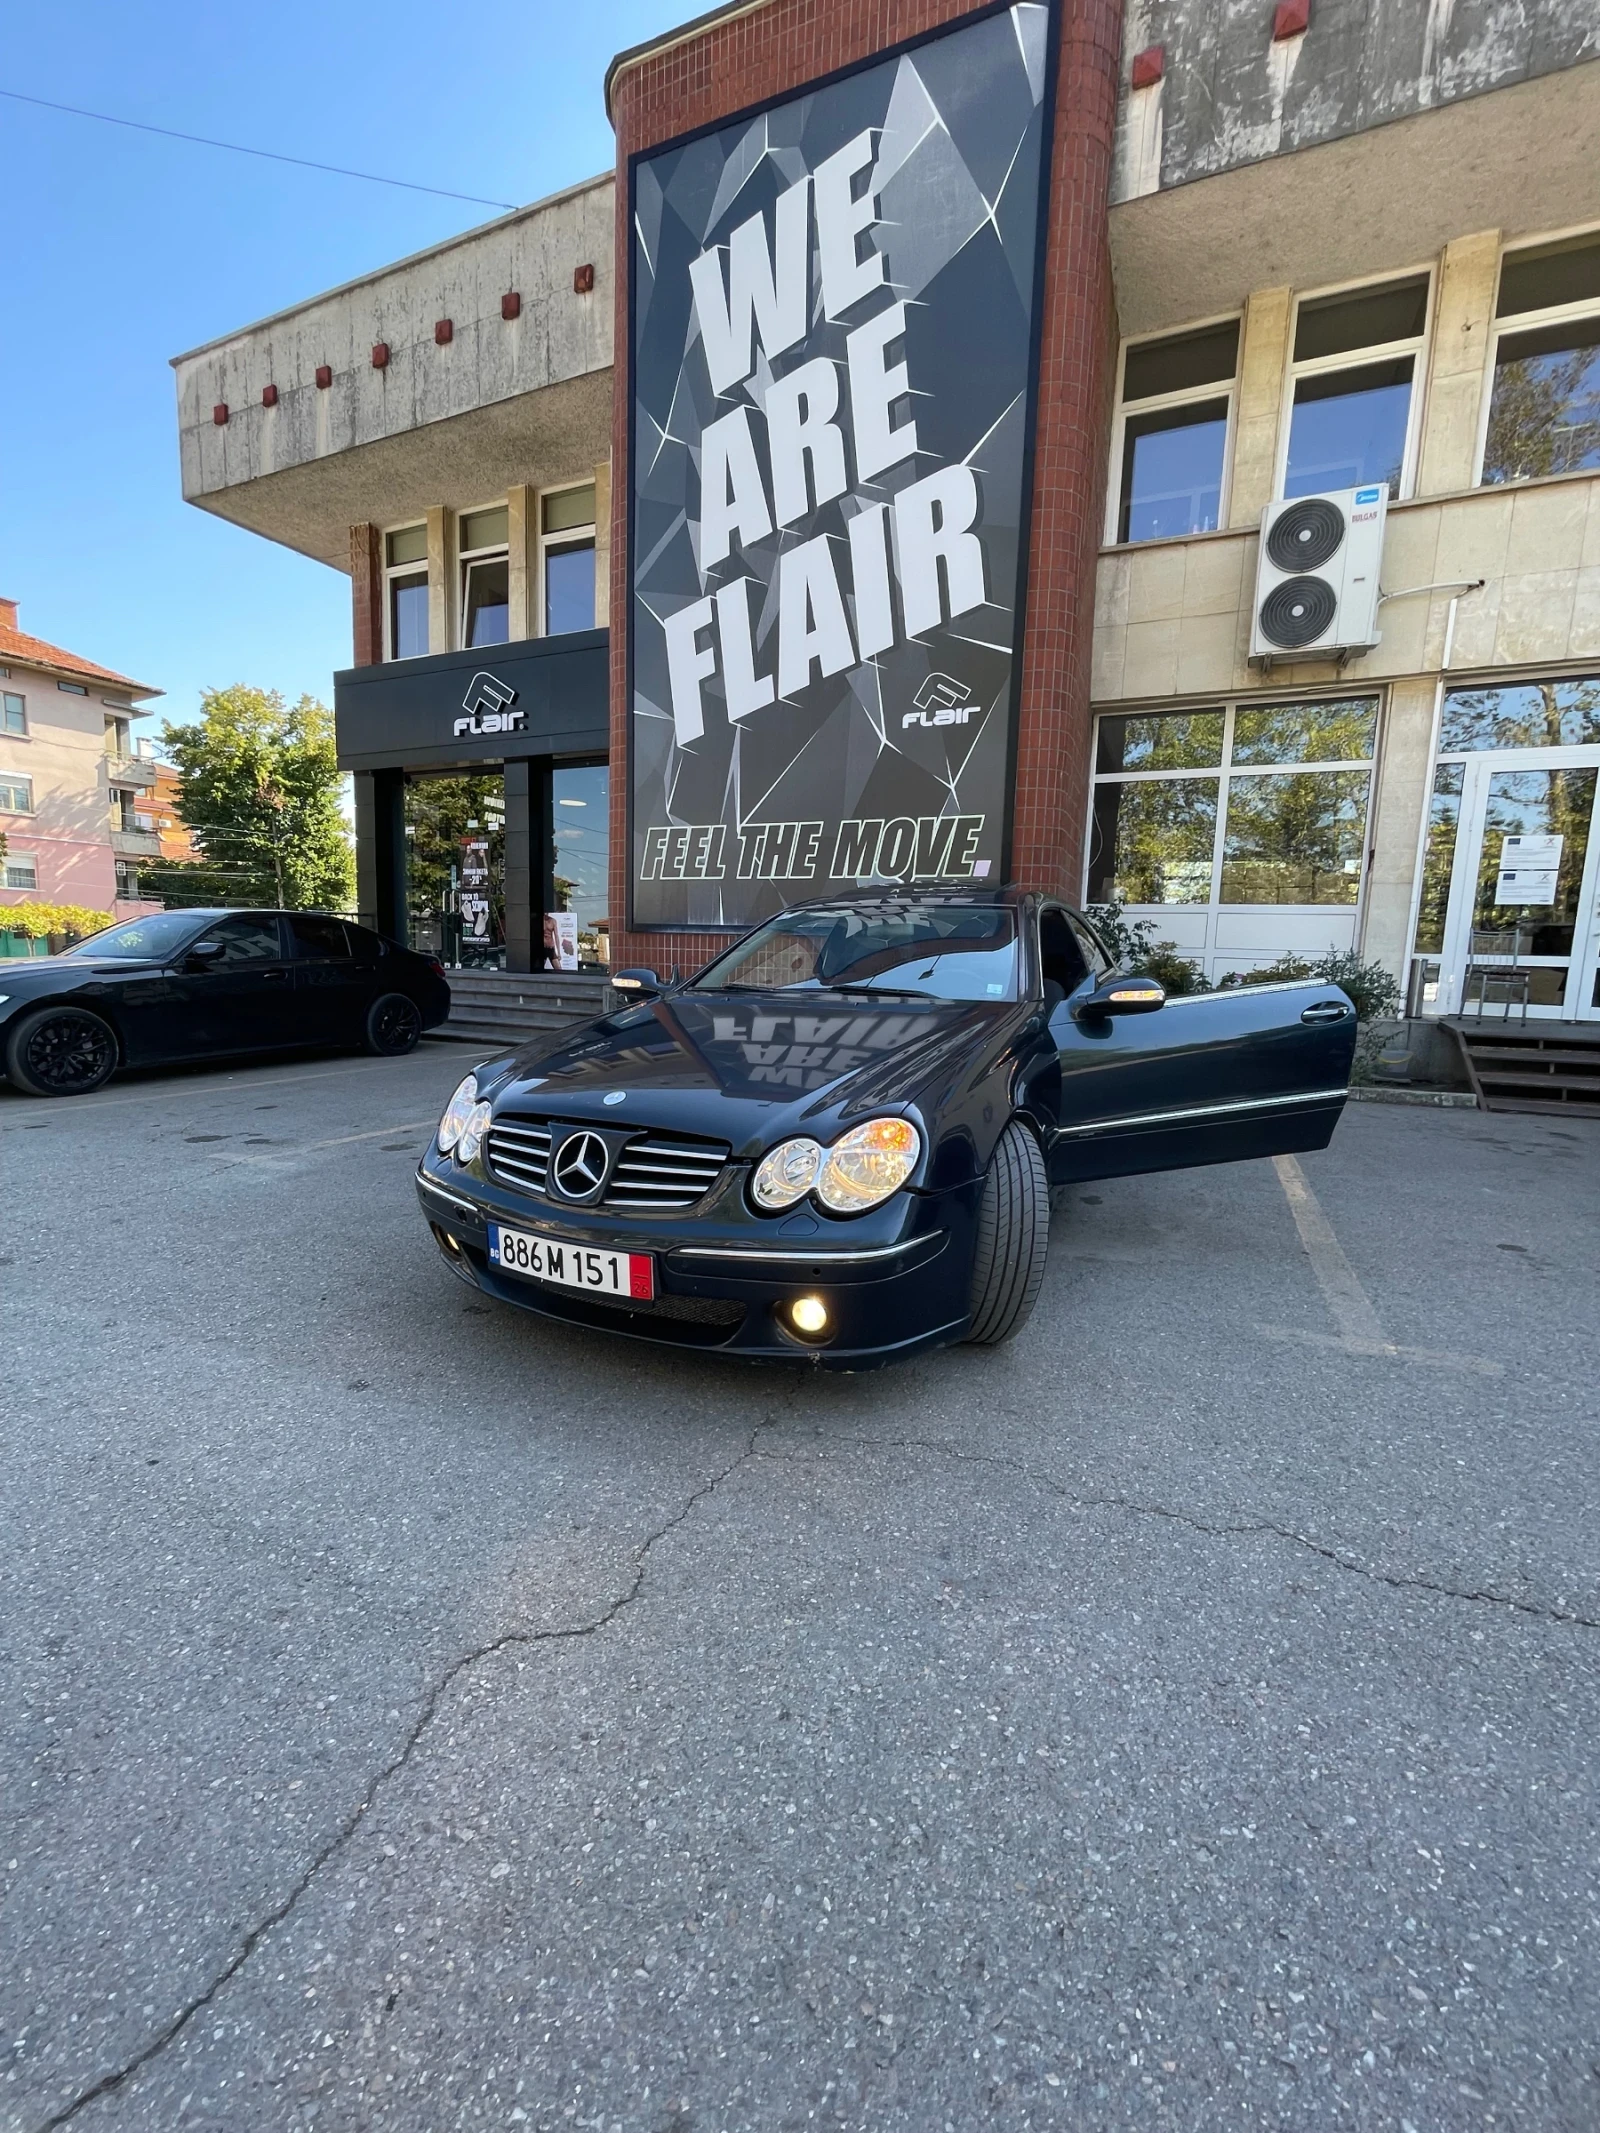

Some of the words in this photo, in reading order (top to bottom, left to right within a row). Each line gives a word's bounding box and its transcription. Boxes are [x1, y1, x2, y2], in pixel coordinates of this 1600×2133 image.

[689, 128, 884, 398] WE
[701, 299, 918, 572] ARE
[664, 464, 986, 748] FLAIR
[639, 824, 728, 881] FEEL
[736, 820, 825, 880] THE
[490, 1247, 500, 1259] BG
[503, 1234, 543, 1273] 886
[547, 1245, 565, 1279] M
[572, 1251, 619, 1289] 151
[634, 1282, 649, 1295] 26
